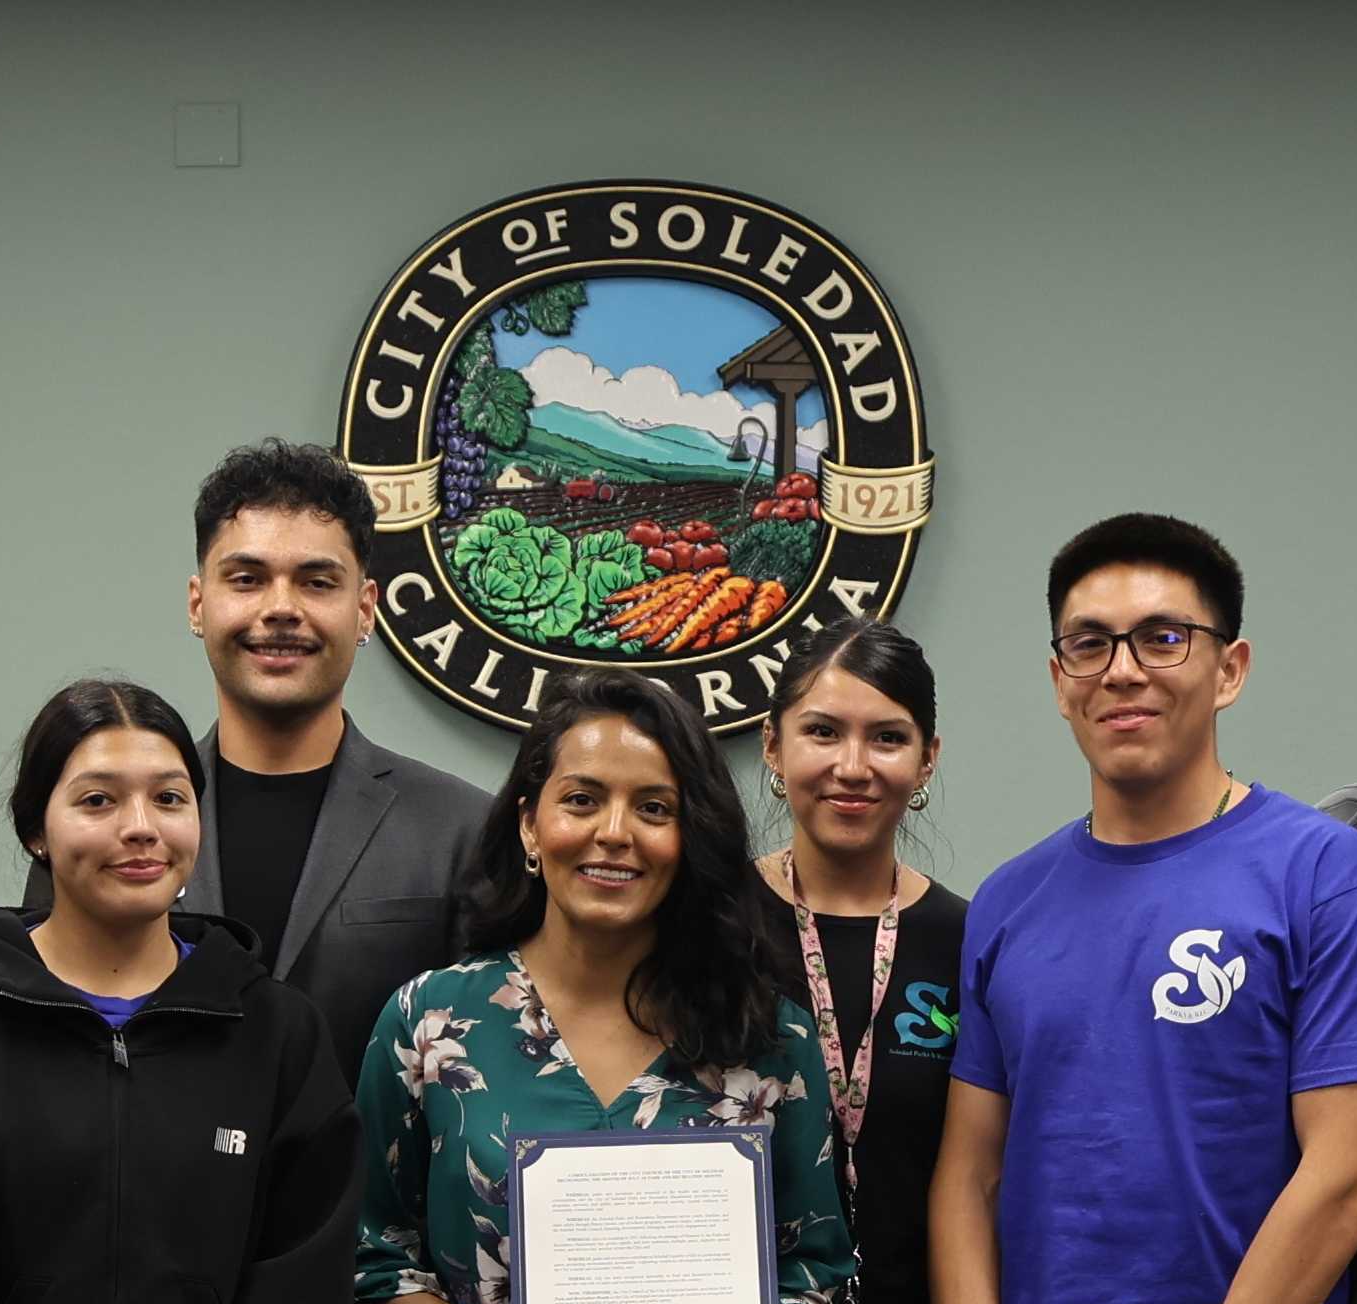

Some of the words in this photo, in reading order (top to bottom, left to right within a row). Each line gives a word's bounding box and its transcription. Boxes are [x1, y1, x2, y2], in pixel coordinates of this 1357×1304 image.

[365, 246, 480, 420] CITY
[502, 208, 568, 253] OF
[609, 201, 897, 423] SOLEDAD
[373, 481, 420, 514] ST.
[839, 483, 916, 518] 1921
[386, 572, 879, 716] CALIRNA
